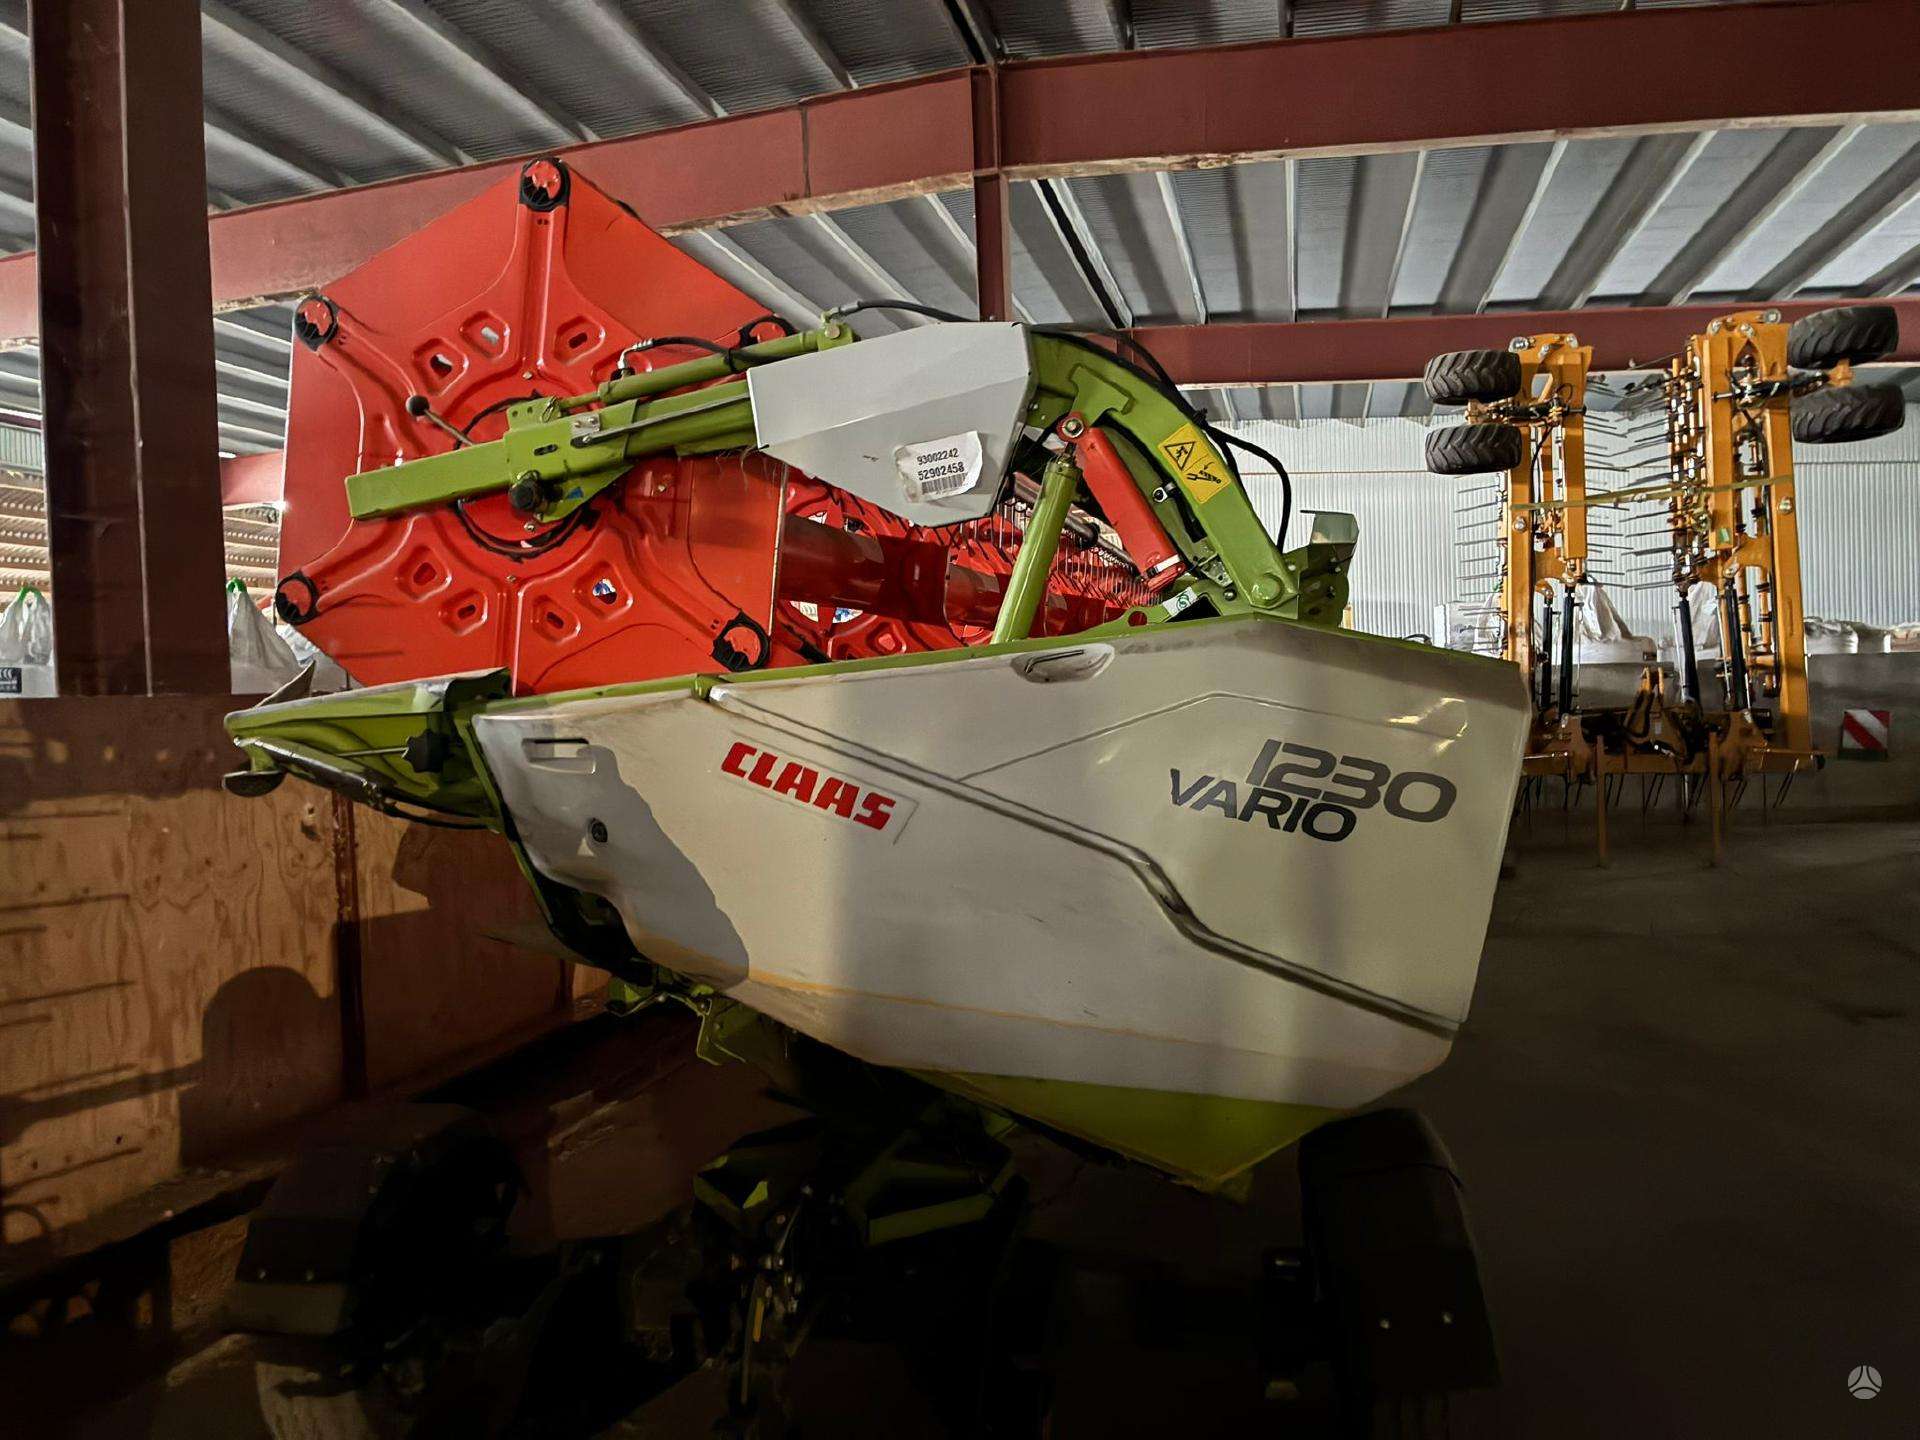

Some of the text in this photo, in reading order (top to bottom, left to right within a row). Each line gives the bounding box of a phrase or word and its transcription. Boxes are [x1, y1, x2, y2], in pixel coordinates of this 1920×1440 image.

[916, 447, 959, 466] 93002242
[917, 461, 965, 481] 52902458
[721, 742, 896, 830] CLAAS
[1170, 768, 1357, 842] VARIO
[1246, 739, 1457, 823] 1230
